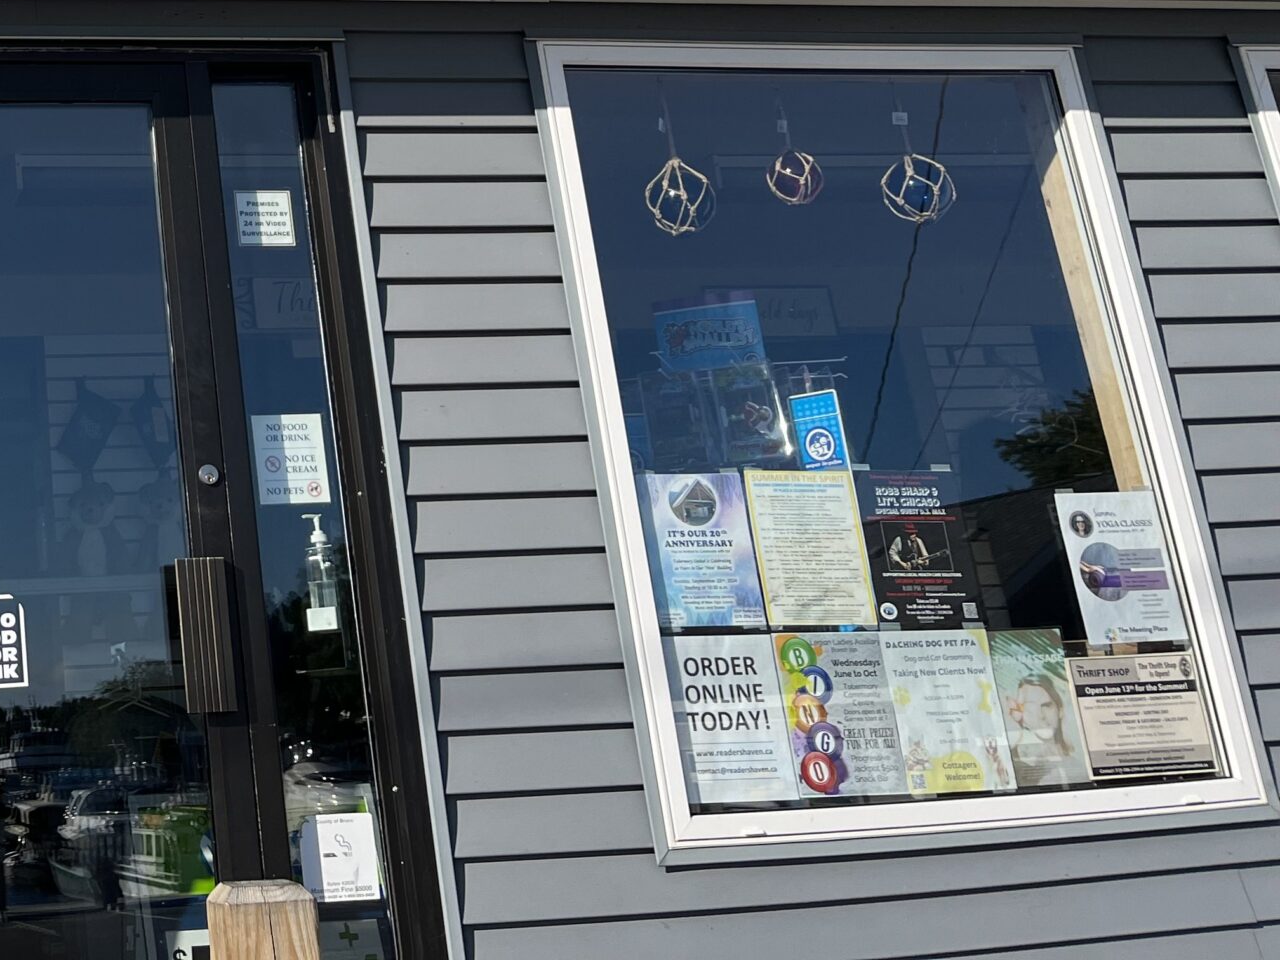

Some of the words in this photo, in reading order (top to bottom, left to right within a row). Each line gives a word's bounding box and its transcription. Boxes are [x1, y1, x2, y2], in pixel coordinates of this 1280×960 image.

[266, 424, 281, 432] NO
[282, 423, 308, 431] FOOD
[266, 434, 279, 442] OR
[285, 455, 299, 463] NO
[266, 487, 282, 495] NO
[283, 487, 304, 495] PETS
[1096, 520, 1118, 528] YOGA
[1120, 519, 1153, 528] CLASSES
[667, 530, 686, 538] IT'S
[687, 530, 708, 538] OUR
[665, 540, 733, 548] ANNIVERSARY
[1129, 625, 1153, 634] Meeting
[885, 640, 924, 649] DACHING
[925, 639, 942, 648] DOG
[944, 639, 958, 647] PET
[683, 656, 758, 677] ORDER
[831, 659, 880, 668] Wednesdays
[834, 670, 852, 678] June
[893, 669, 919, 678] Taking
[920, 668, 937, 676] New
[938, 667, 966, 675] Clients
[1077, 669, 1106, 678] THRIFT
[1108, 668, 1130, 676] SHOP
[685, 683, 765, 704] ONLINE
[1084, 686, 1104, 696] Open
[1104, 685, 1121, 693] June
[1135, 684, 1145, 692] for
[1146, 683, 1157, 691] the
[1158, 682, 1188, 690] Summer!
[686, 709, 771, 731] TODAY!
[696, 748, 773, 757] www.readershaven.ca
